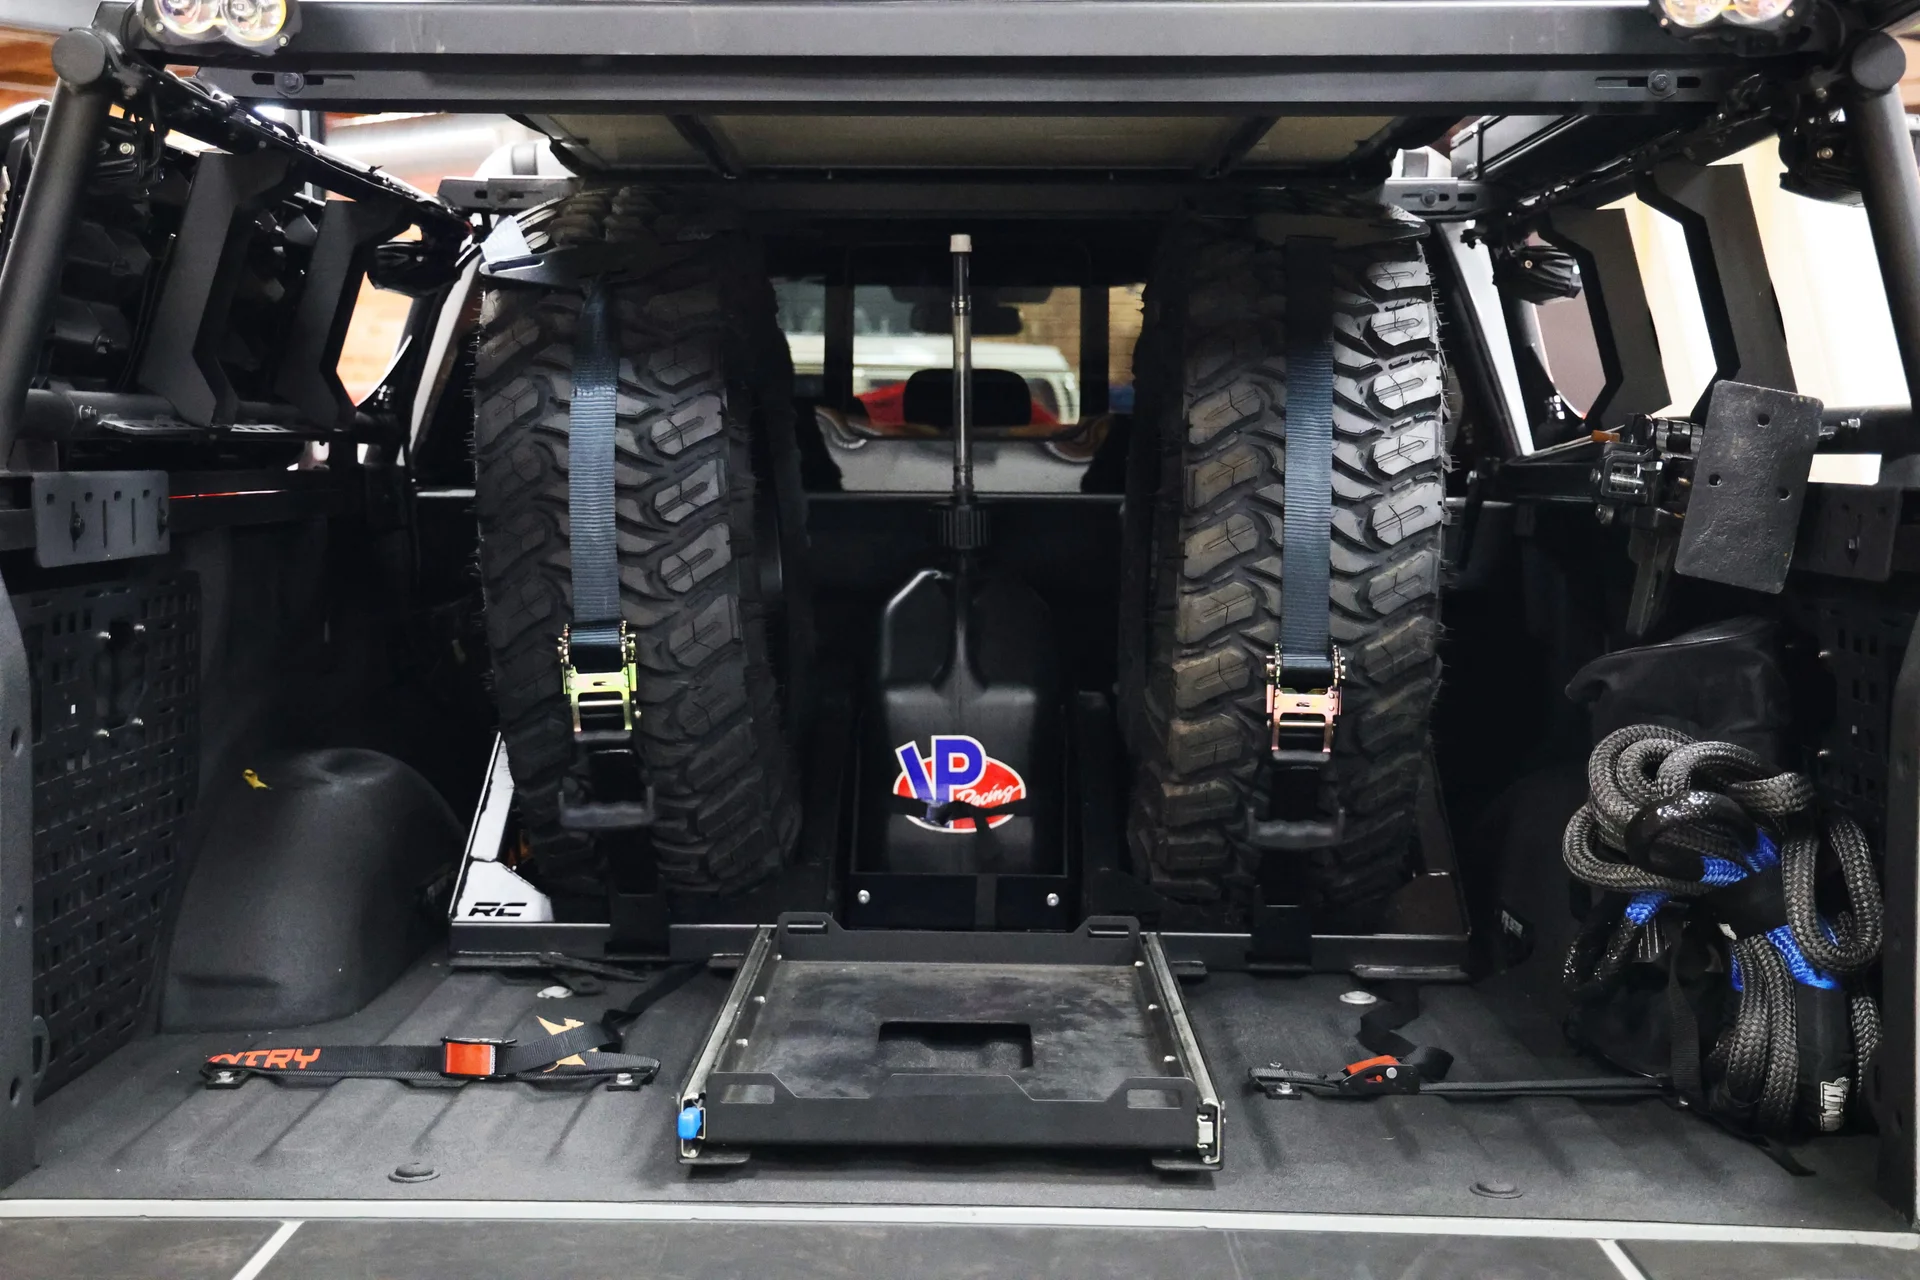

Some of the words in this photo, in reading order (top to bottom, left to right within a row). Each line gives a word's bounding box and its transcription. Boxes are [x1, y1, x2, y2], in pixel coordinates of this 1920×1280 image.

[955, 783, 1021, 807] Racing
[468, 902, 527, 917] RC
[207, 1048, 321, 1070] NTRY
